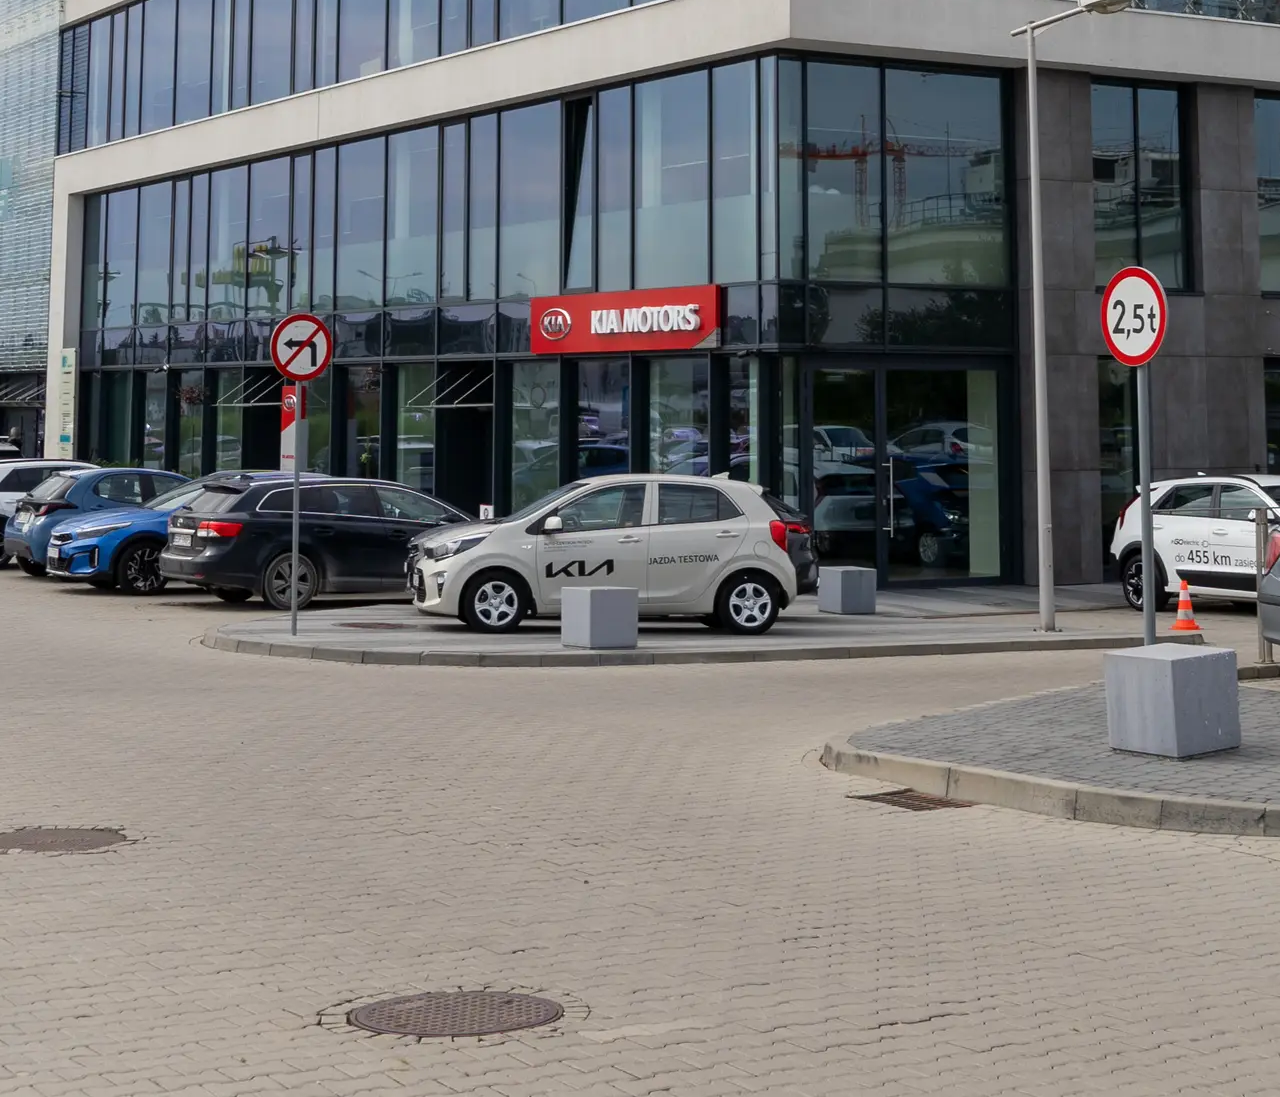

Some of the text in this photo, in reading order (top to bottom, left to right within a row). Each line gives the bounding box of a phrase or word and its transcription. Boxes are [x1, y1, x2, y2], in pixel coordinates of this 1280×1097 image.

[543, 315, 565, 333] KIA
[591, 304, 701, 334] KIA MOTORS
[648, 554, 720, 566] JAZDA TESTOWA
[1175, 553, 1186, 563] do
[1187, 550, 1210, 564] 455
[1212, 551, 1232, 566] km
[545, 559, 615, 579] KIA
